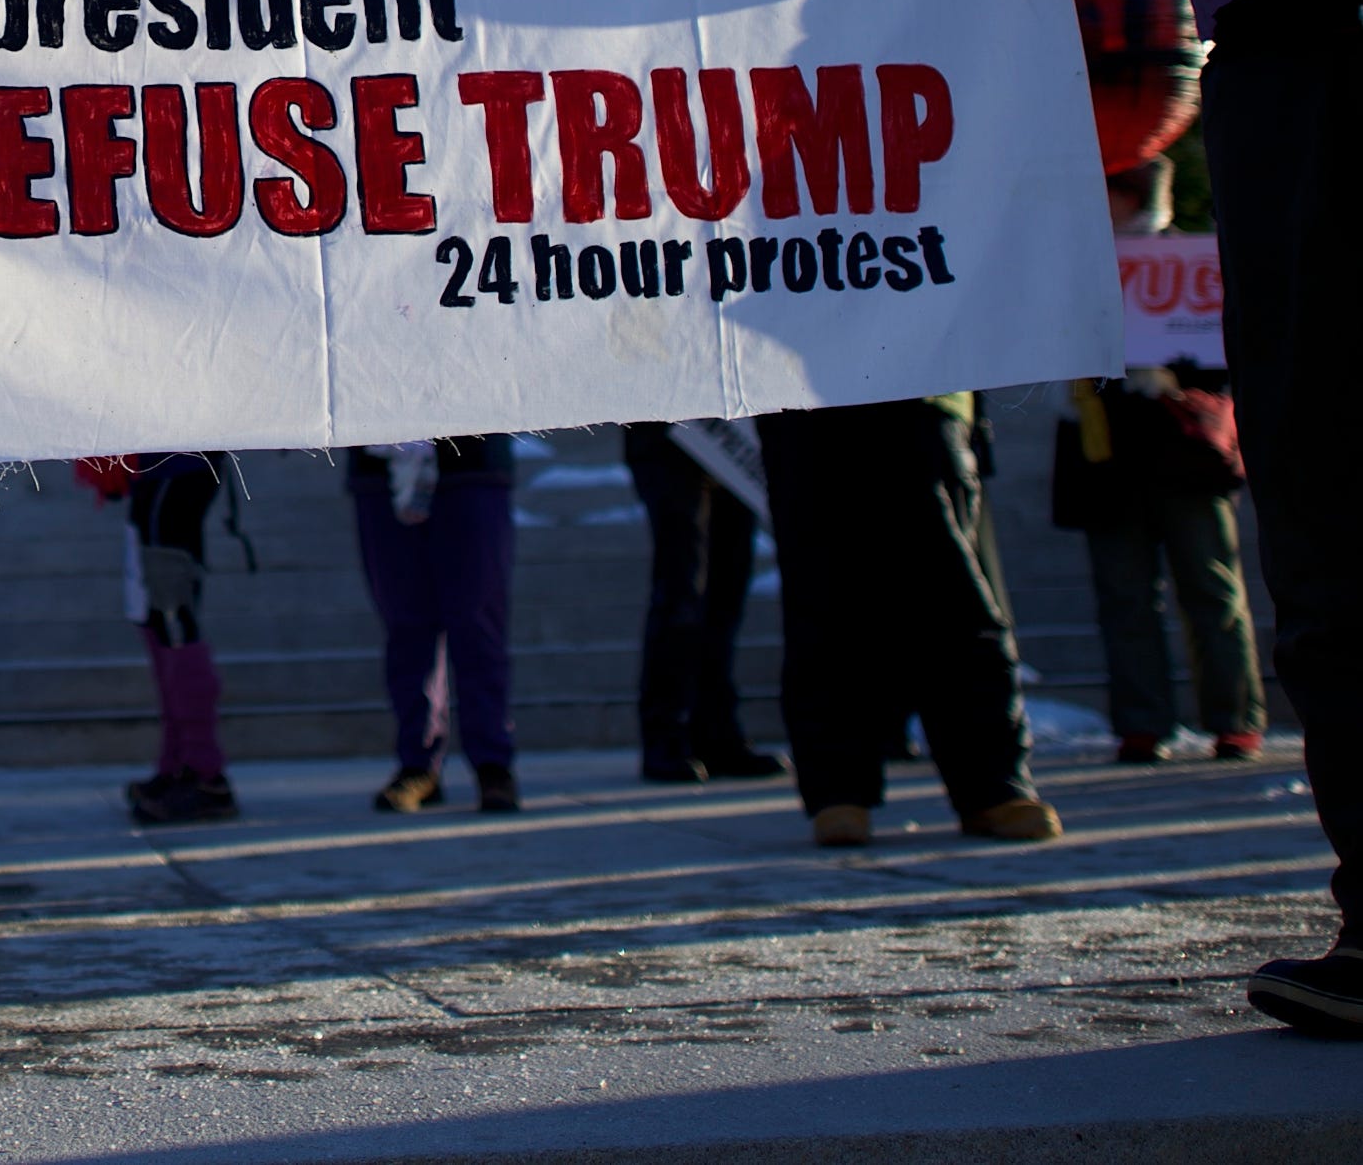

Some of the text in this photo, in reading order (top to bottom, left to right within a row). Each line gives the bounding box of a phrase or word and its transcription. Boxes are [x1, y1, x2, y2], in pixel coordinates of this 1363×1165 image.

[457, 63, 955, 224] TRUMP
[436, 225, 956, 307] 24 hour protest
